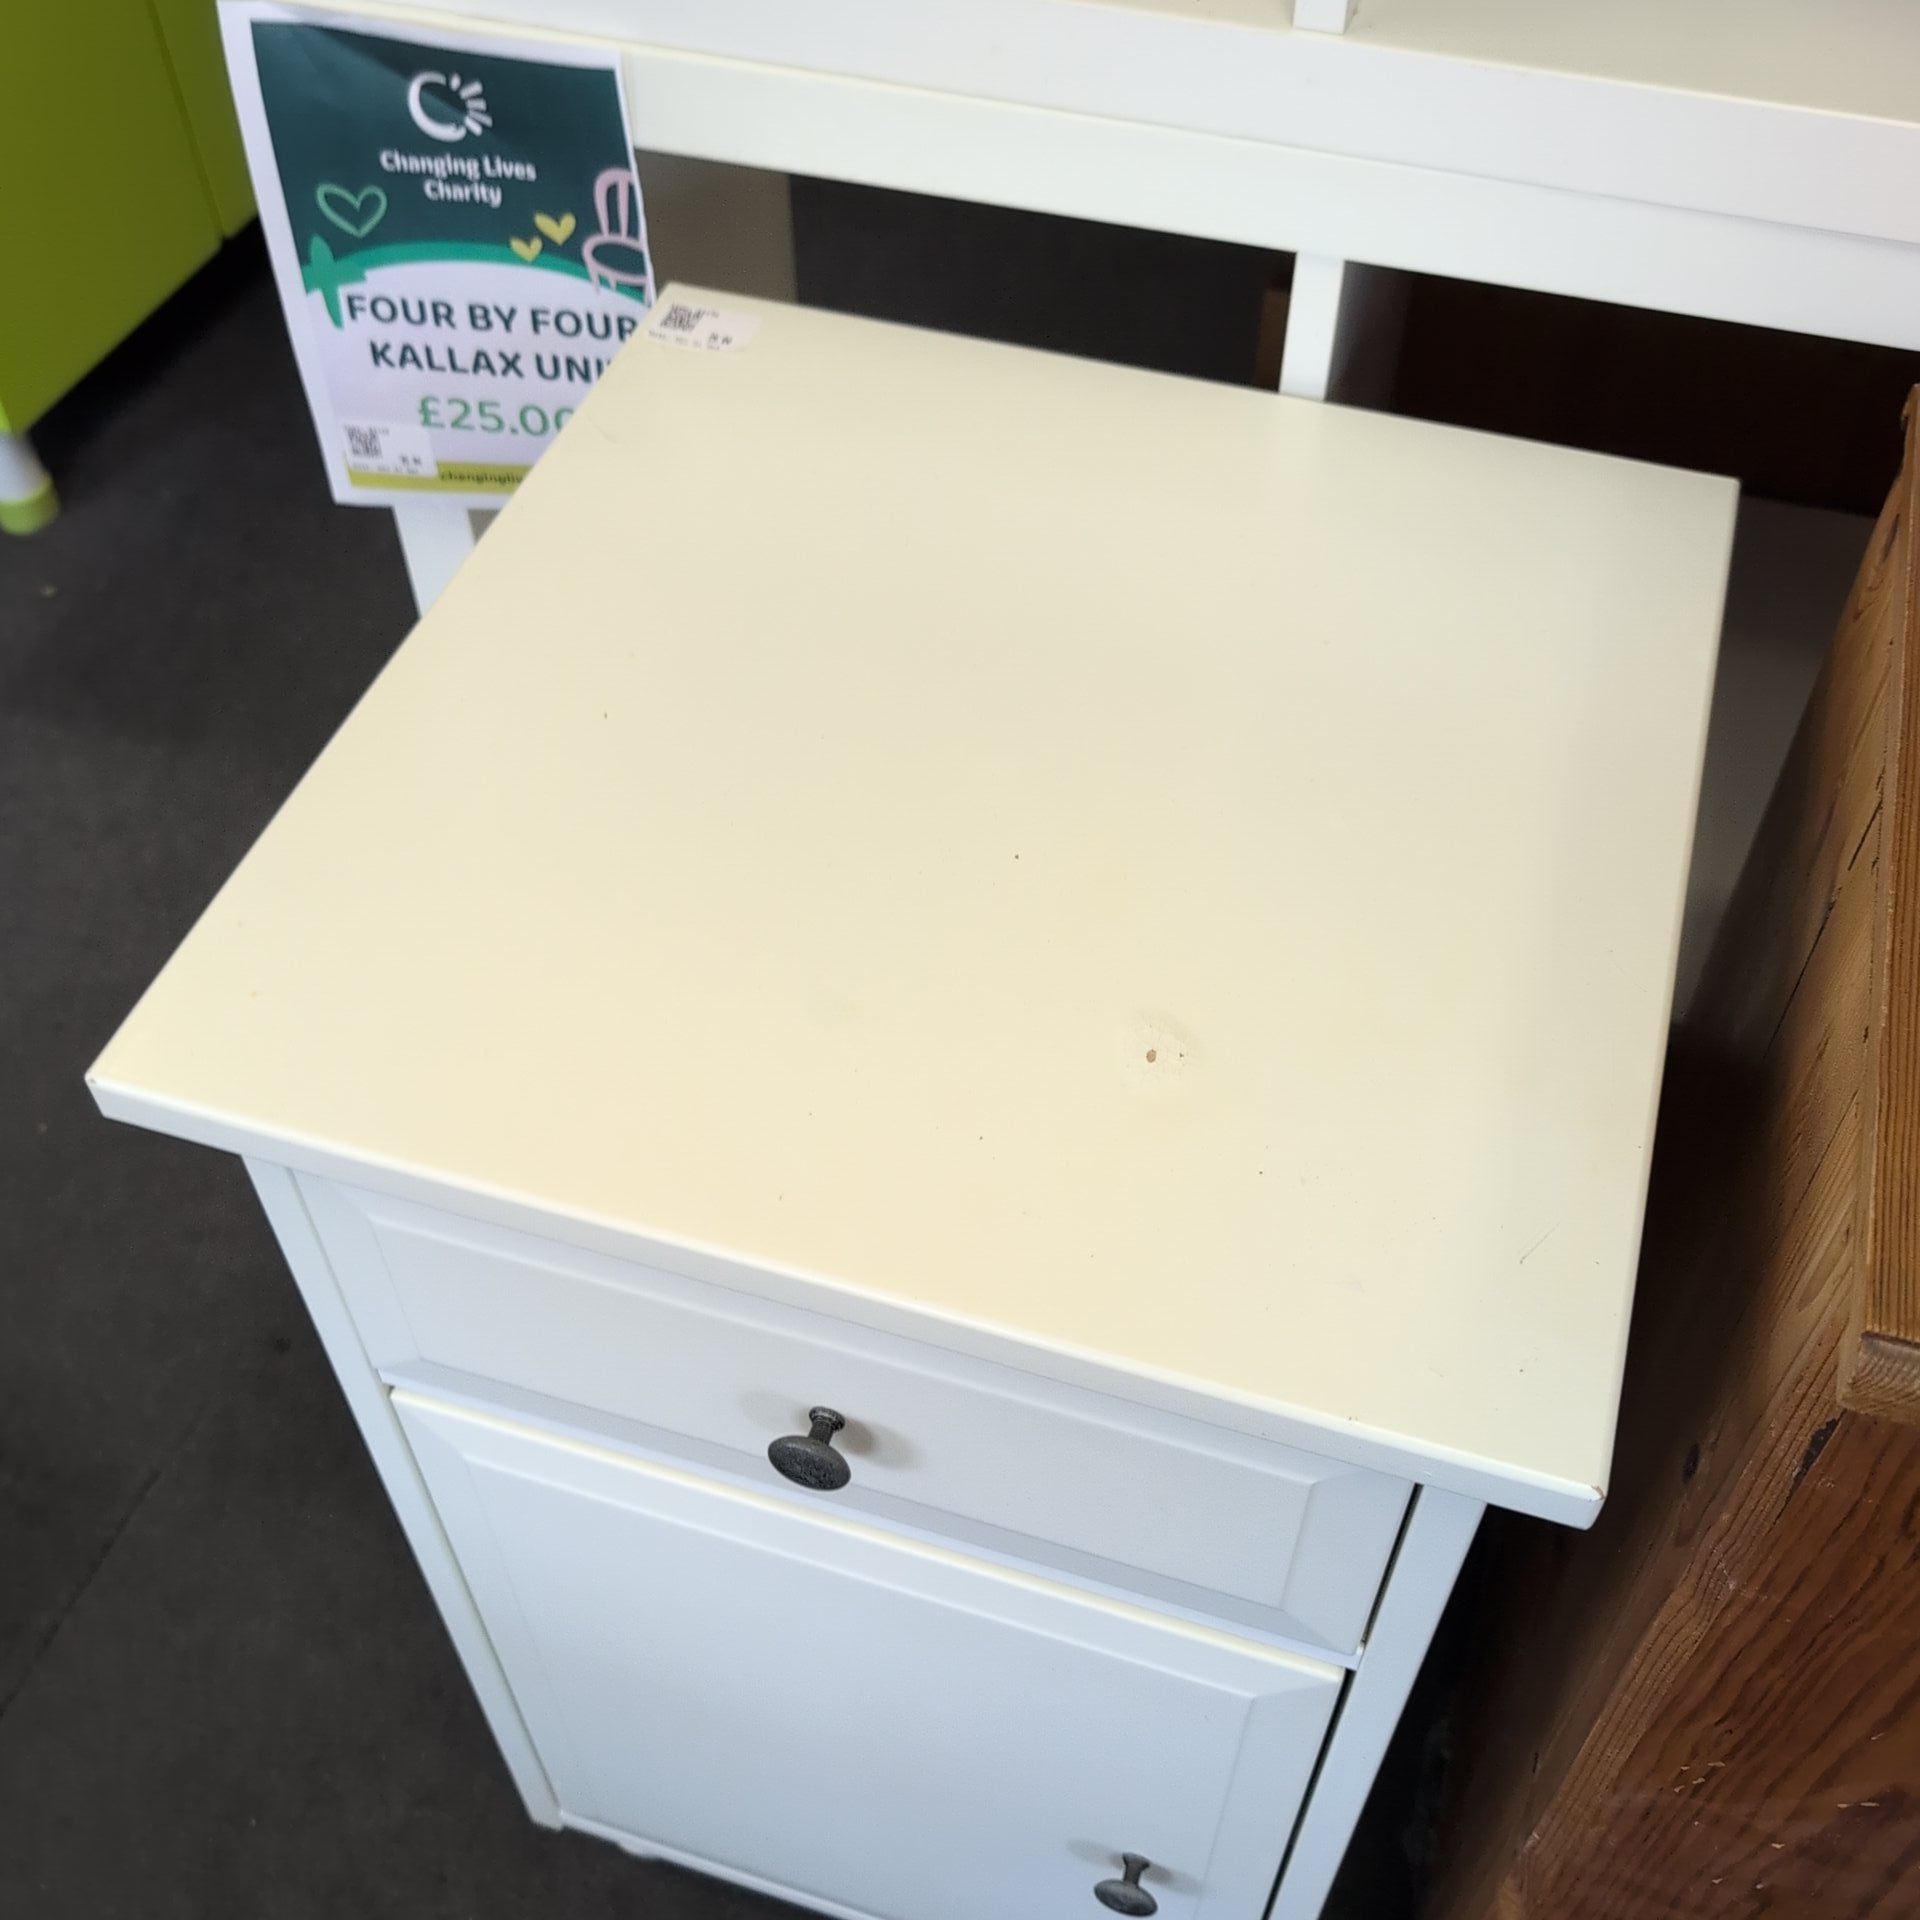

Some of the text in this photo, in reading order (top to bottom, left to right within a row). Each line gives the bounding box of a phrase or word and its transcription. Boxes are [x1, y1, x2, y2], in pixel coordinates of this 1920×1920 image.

[379, 150, 537, 182] Changing Lives
[423, 178, 502, 209] Charity
[346, 295, 456, 329] FOUR
[468, 303, 517, 333] BY
[530, 309, 637, 342] FOUR
[370, 340, 611, 384] KALLAX UNI
